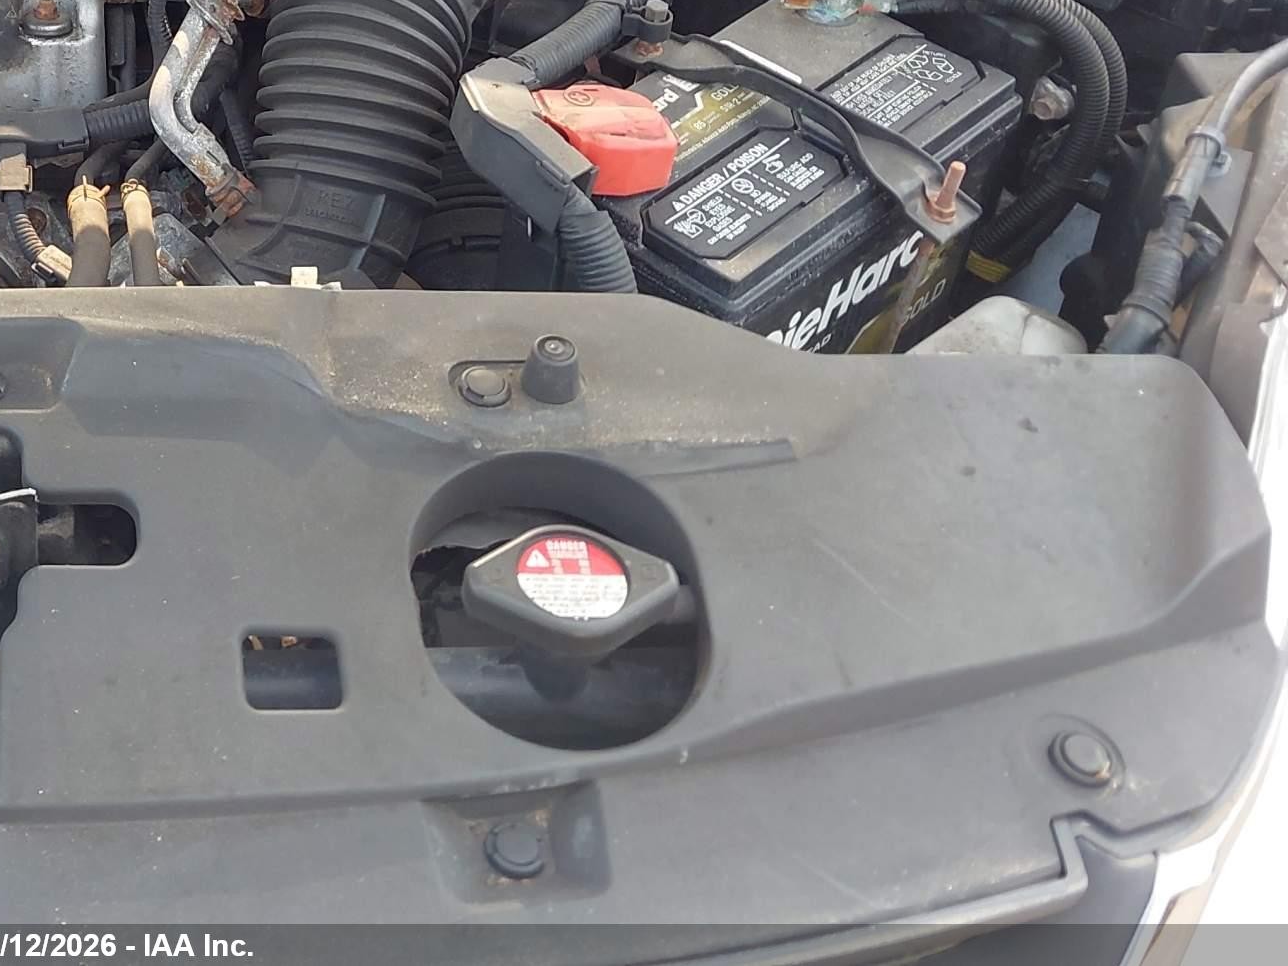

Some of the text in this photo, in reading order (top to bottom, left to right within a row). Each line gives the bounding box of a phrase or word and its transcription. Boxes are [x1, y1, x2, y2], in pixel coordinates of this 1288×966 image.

[679, 172, 726, 207] DANGER
[726, 142, 770, 173] POISON
[808, 333, 832, 354] EAD
